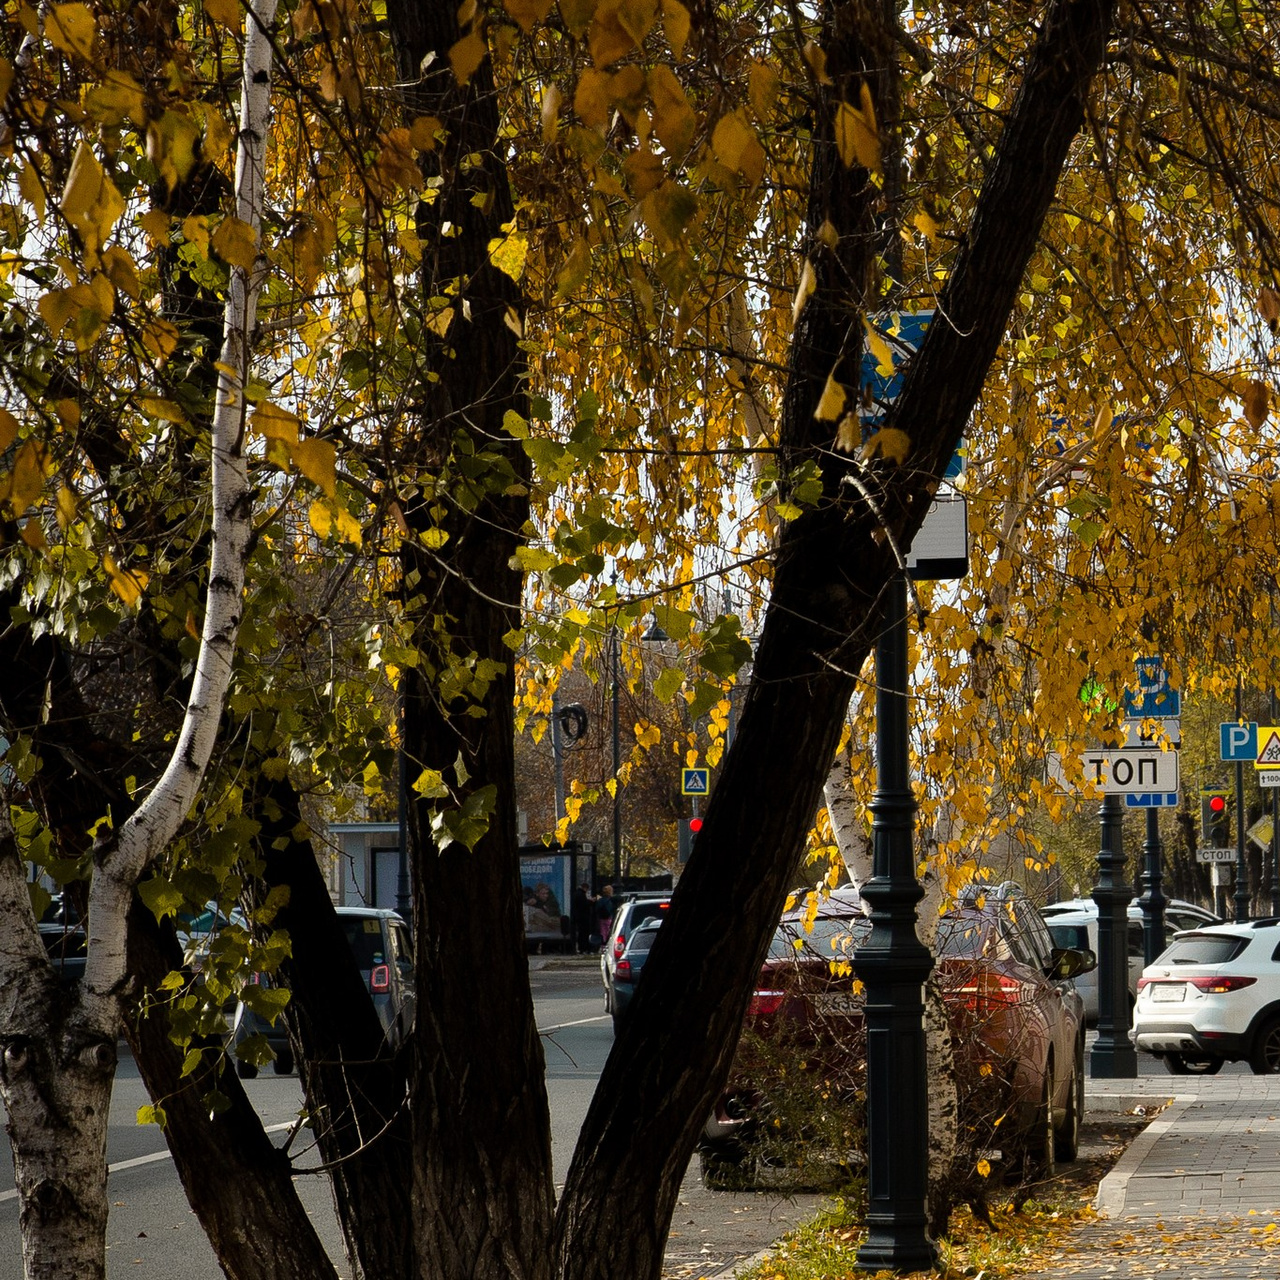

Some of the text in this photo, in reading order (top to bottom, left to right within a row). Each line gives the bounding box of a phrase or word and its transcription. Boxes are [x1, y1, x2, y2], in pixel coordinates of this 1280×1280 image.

[1229, 726, 1250, 757] P
[1067, 758, 1158, 786] ТОП
[1202, 849, 1231, 861] СТОП
